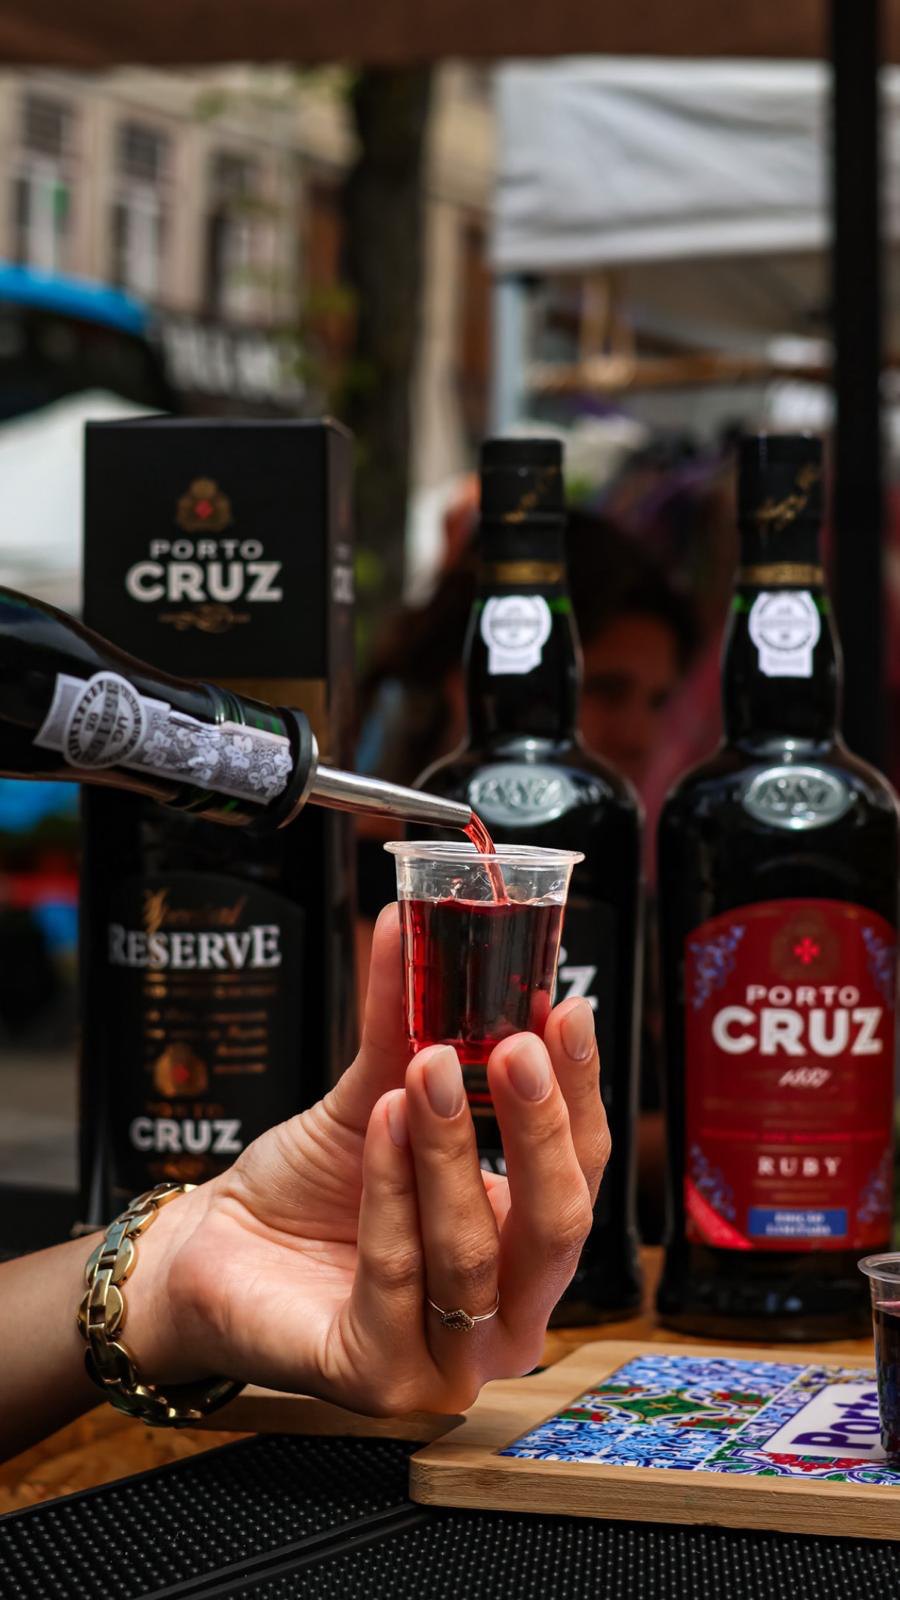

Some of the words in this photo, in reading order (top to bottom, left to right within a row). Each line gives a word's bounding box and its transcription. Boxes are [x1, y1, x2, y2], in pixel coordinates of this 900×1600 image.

[150, 539, 264, 560] PORTO
[125, 561, 283, 602] CRUZ
[108, 922, 283, 969] RESERVE
[745, 985, 861, 1007] PORTO
[712, 1006, 883, 1056] CRUZ
[130, 1117, 242, 1153] CRUZ
[757, 1156, 842, 1177] RUBY
